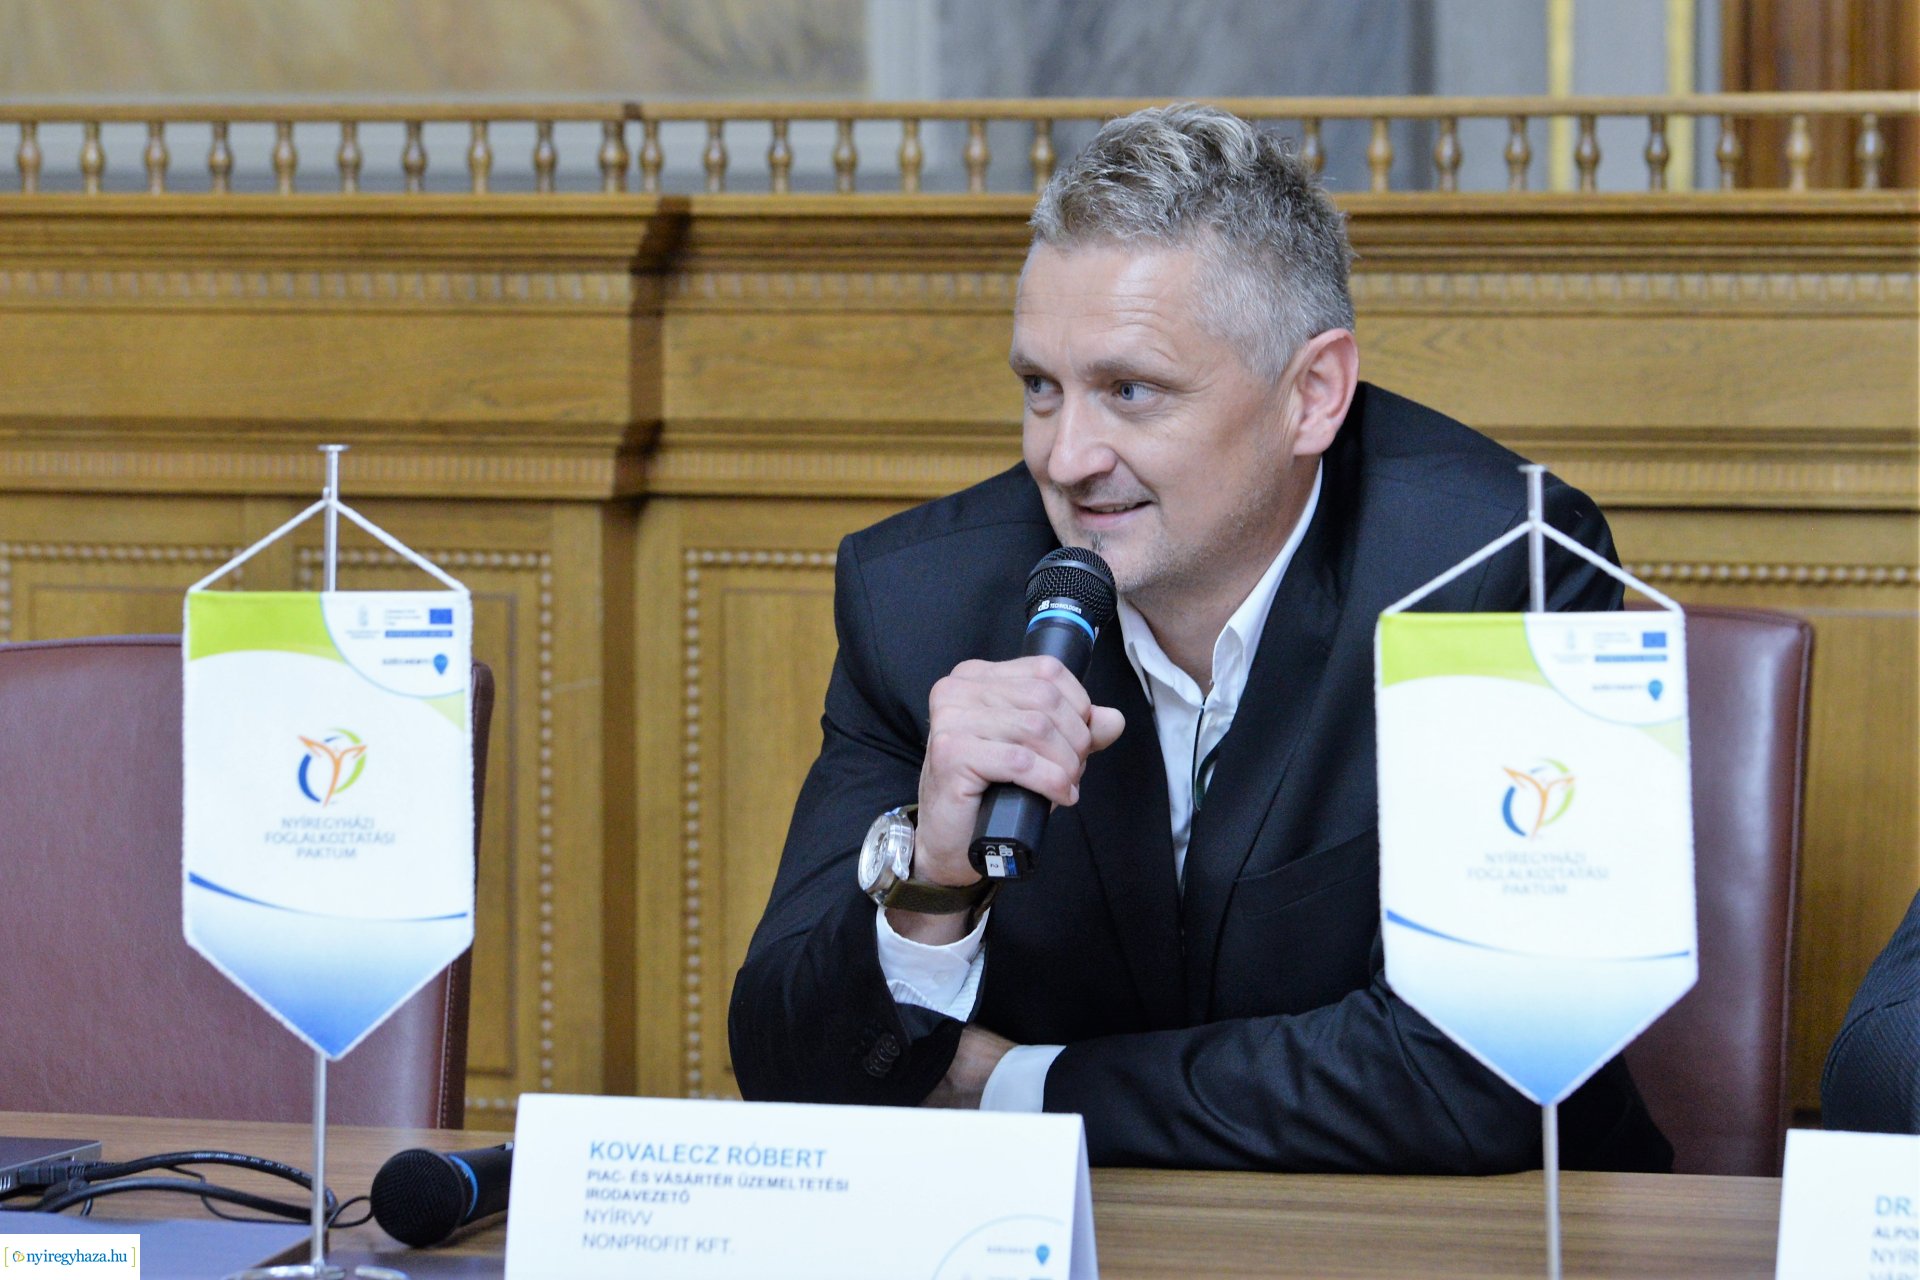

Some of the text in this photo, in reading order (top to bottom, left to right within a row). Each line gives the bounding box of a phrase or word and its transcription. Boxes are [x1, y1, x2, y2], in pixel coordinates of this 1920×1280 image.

[297, 847, 356, 858] PAKTUM
[590, 1141, 828, 1169] KOVALECZ RÓBERT
[630, 1170, 649, 1184] ÉS
[655, 1171, 733, 1188] VÁSÁRTÉR
[737, 1174, 849, 1192] ÜZEMELTETÉSI
[583, 1232, 690, 1252] NONPROFIT
